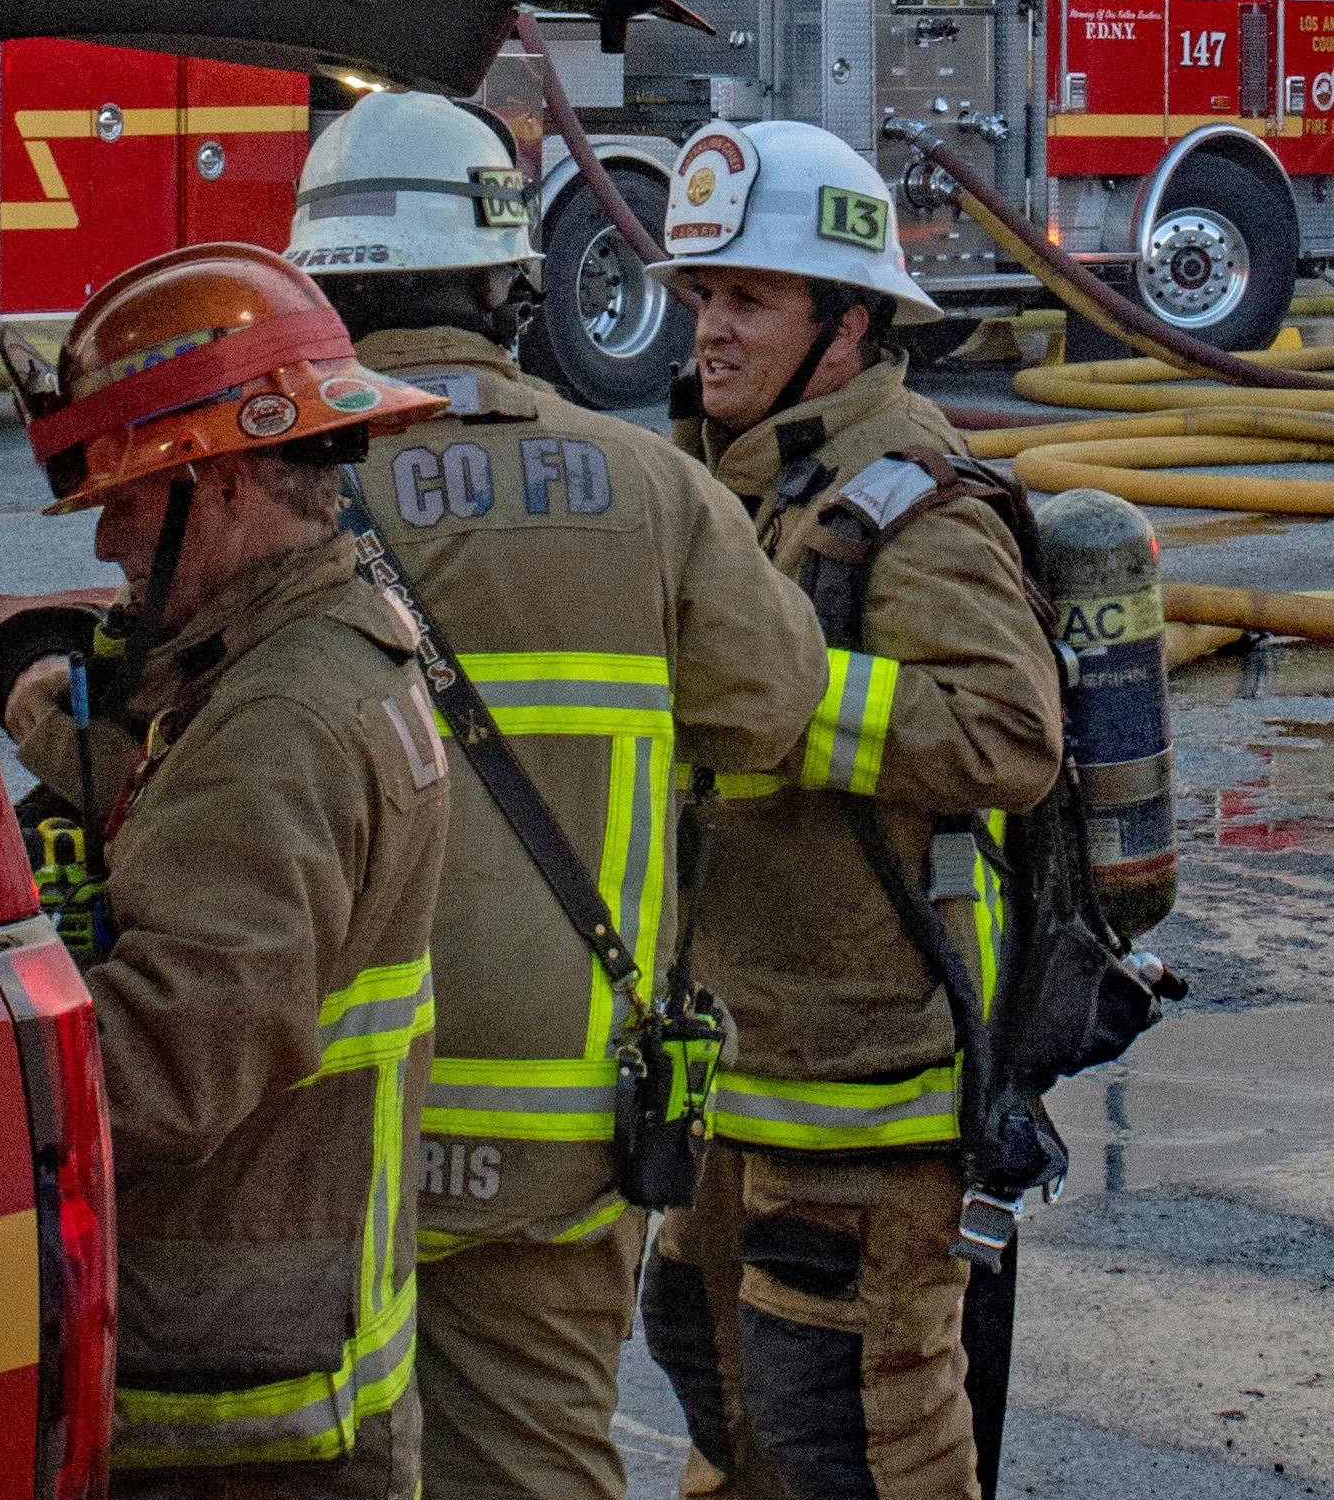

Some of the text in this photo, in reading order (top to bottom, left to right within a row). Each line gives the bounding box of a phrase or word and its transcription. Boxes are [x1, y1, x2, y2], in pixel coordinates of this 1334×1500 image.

[1299, 16, 1319, 32] LOS
[1179, 30, 1227, 67] 147
[831, 194, 879, 239] 13
[392, 437, 614, 528] CO FD
[418, 1140, 502, 1200] RIS
